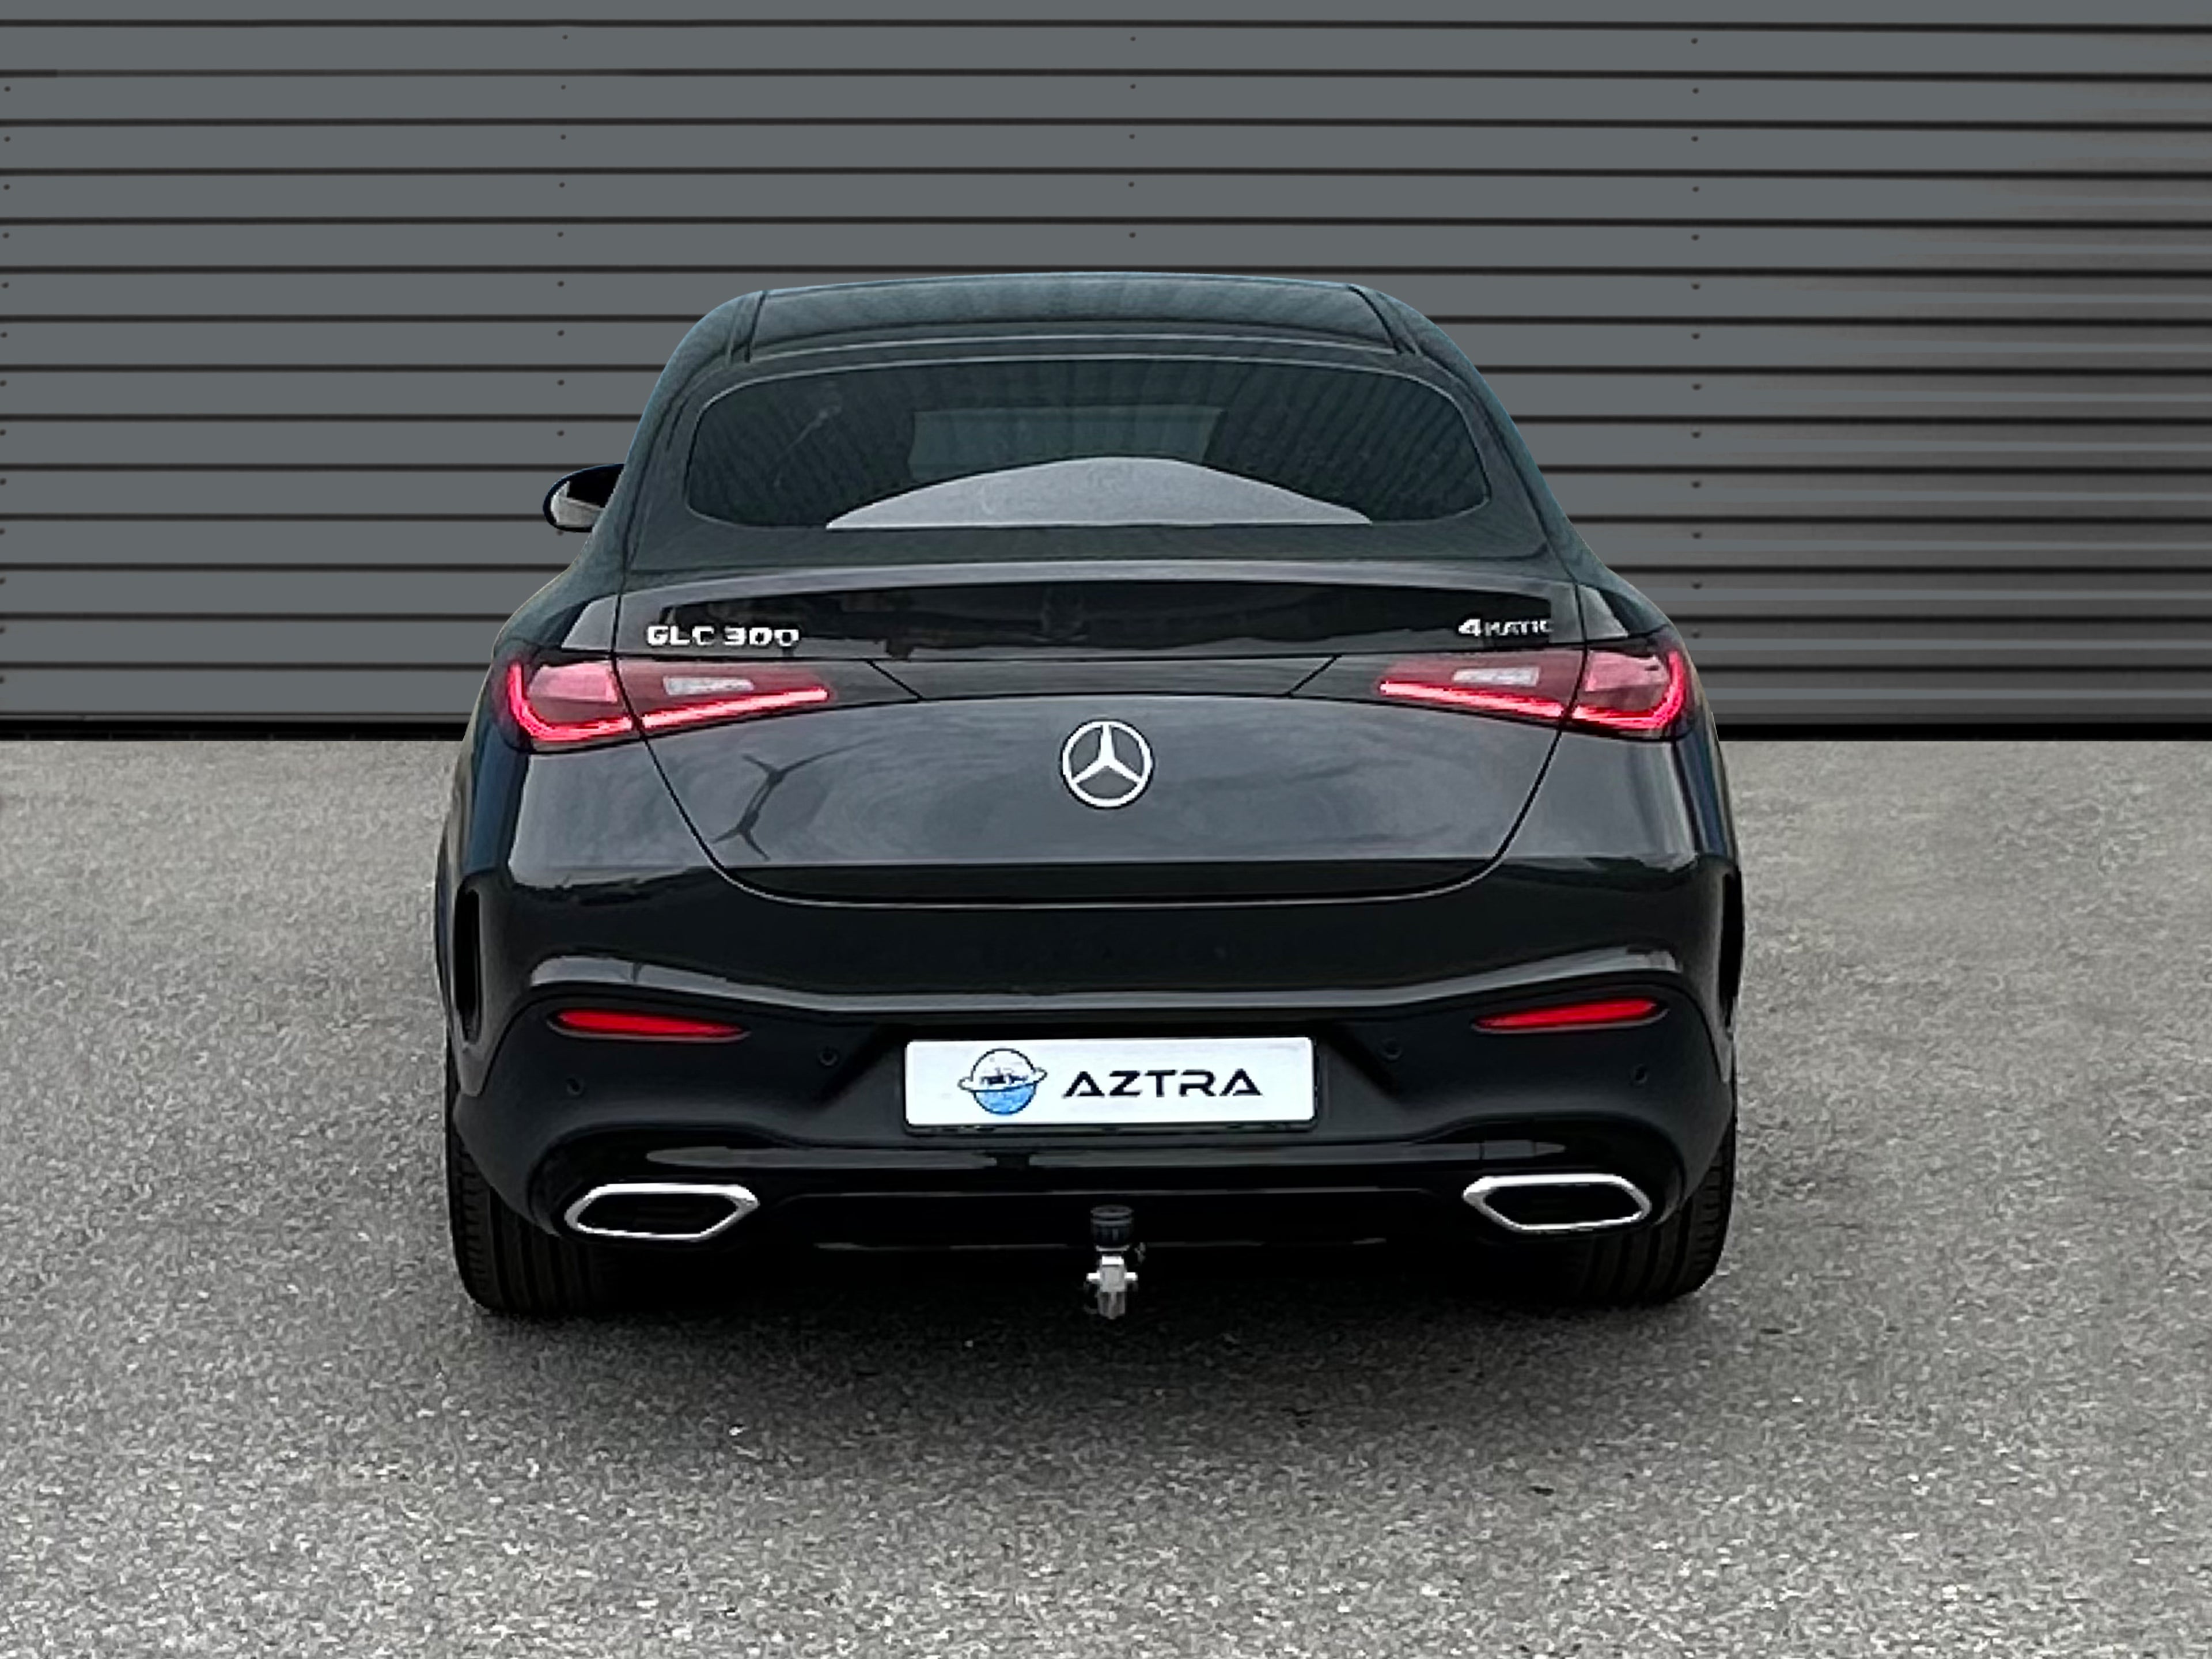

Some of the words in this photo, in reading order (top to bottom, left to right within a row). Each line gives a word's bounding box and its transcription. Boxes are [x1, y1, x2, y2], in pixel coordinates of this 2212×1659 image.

[647, 625, 715, 646] GLC
[723, 625, 800, 647] 300
[1063, 1068, 1264, 1097] AZTRA
